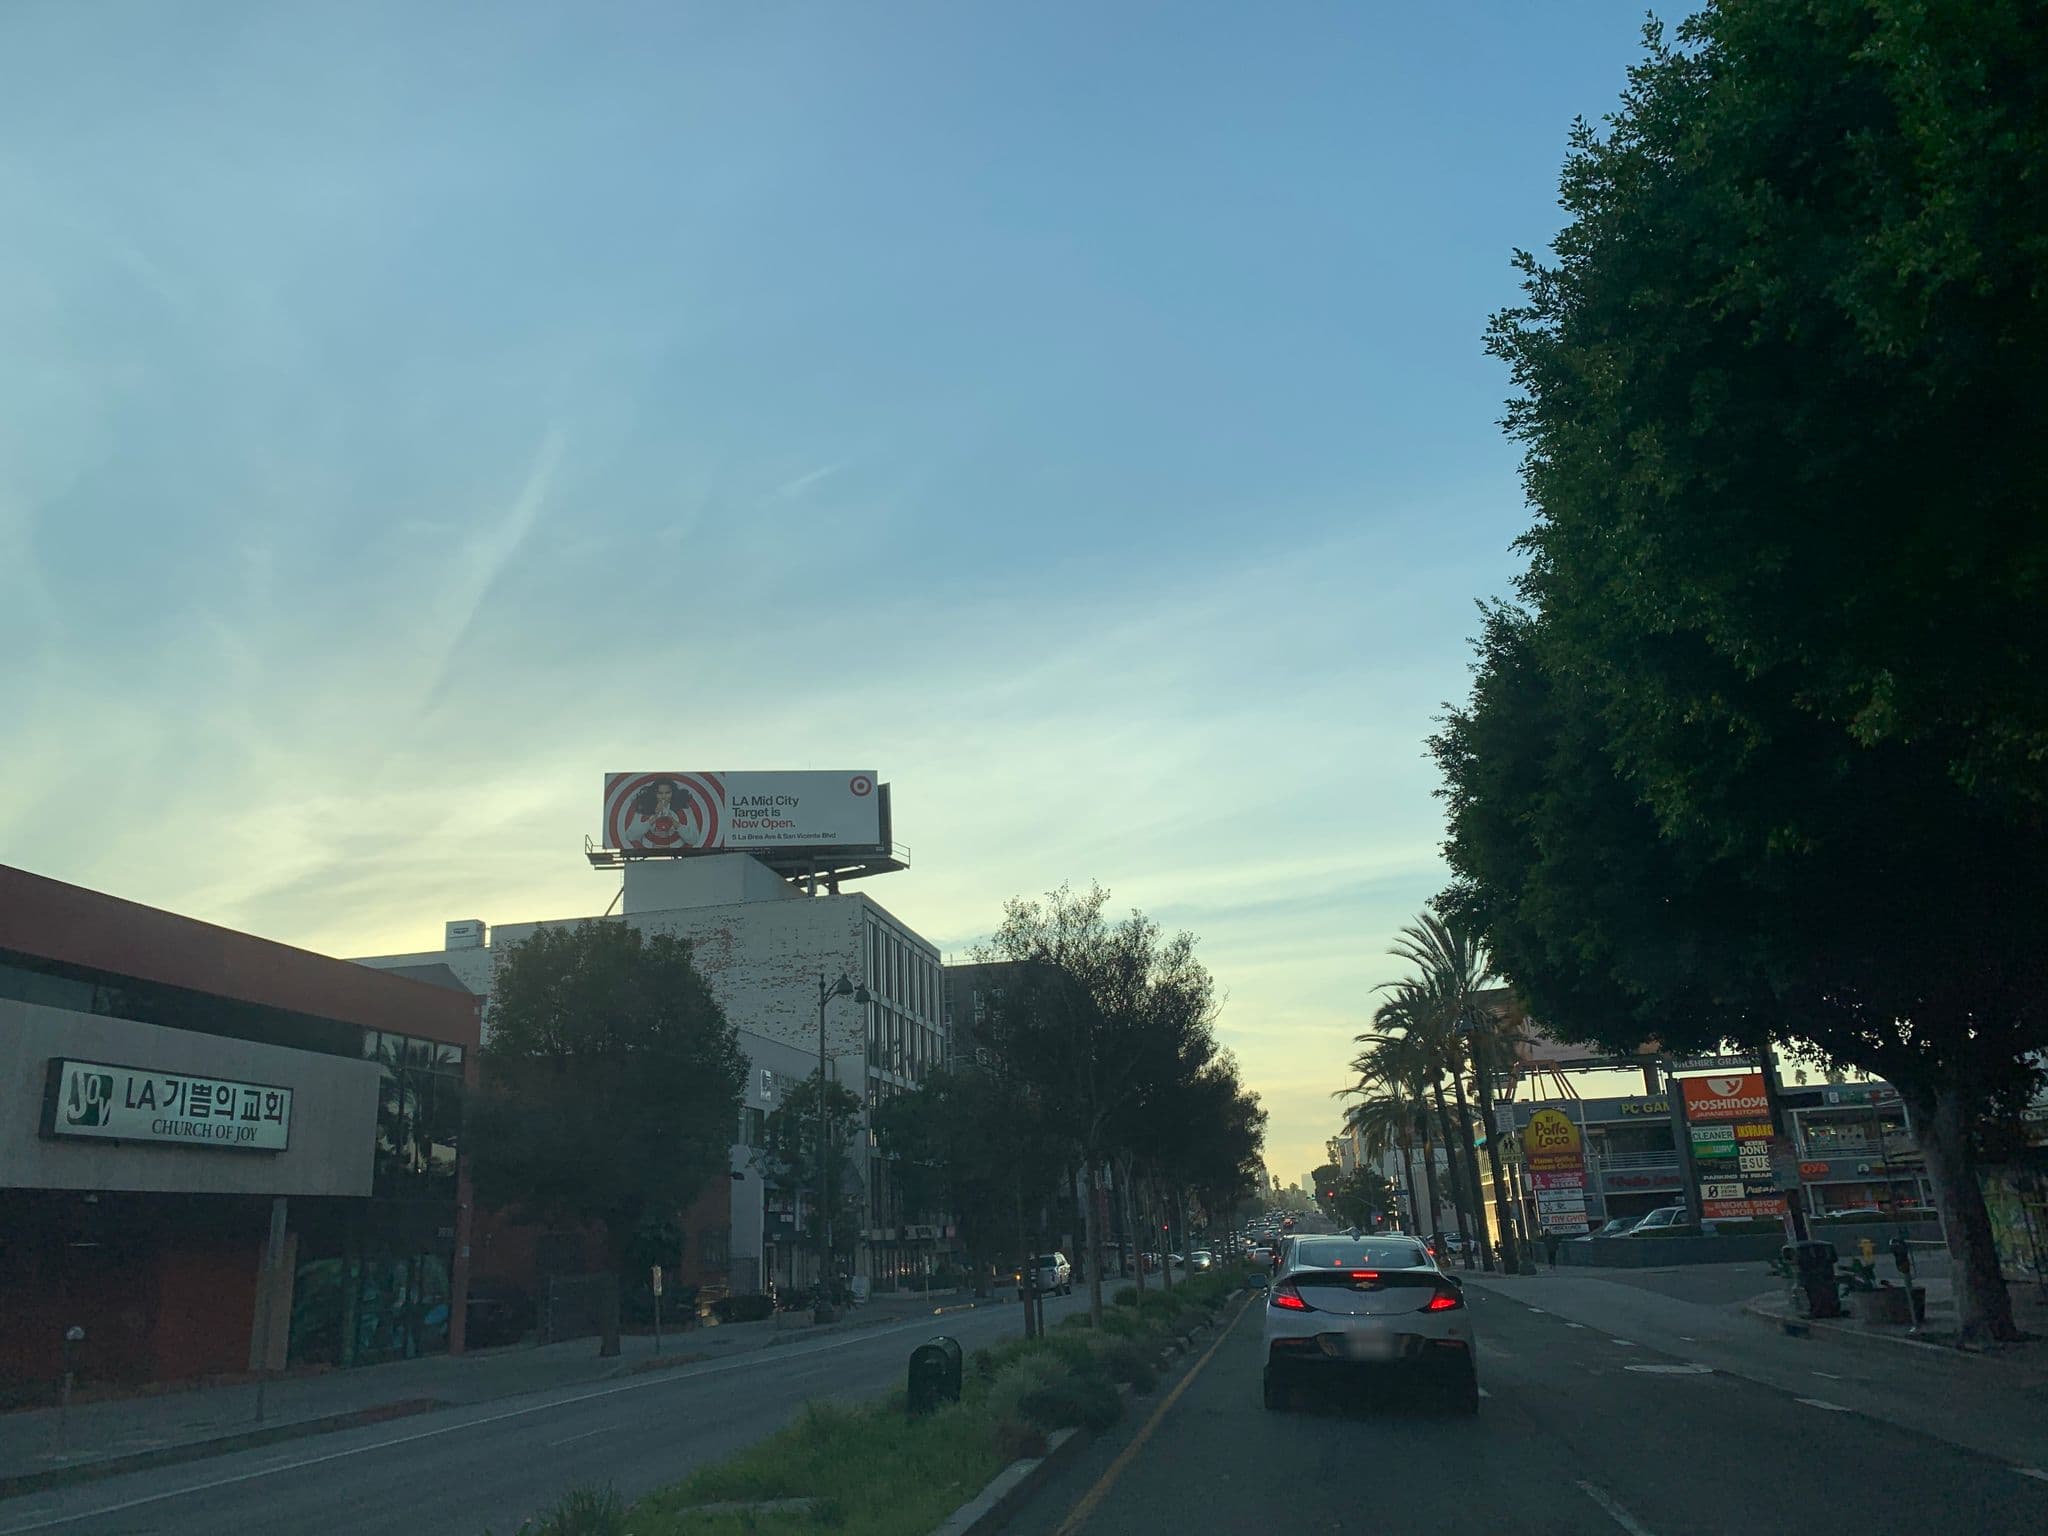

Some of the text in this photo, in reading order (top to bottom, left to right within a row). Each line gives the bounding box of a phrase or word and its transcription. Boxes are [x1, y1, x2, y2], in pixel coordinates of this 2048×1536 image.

[732, 795, 799, 807] LA Mid City
[732, 807, 780, 819] Target is
[732, 818, 796, 830] Now Open.
[1621, 1103, 1639, 1114] PC
[152, 1118, 258, 1143] CHURCH OF JOY
[1535, 1122, 1568, 1136] Pollo
[1538, 1134, 1570, 1148] Loco
[1739, 1145, 1768, 1155] DONU
